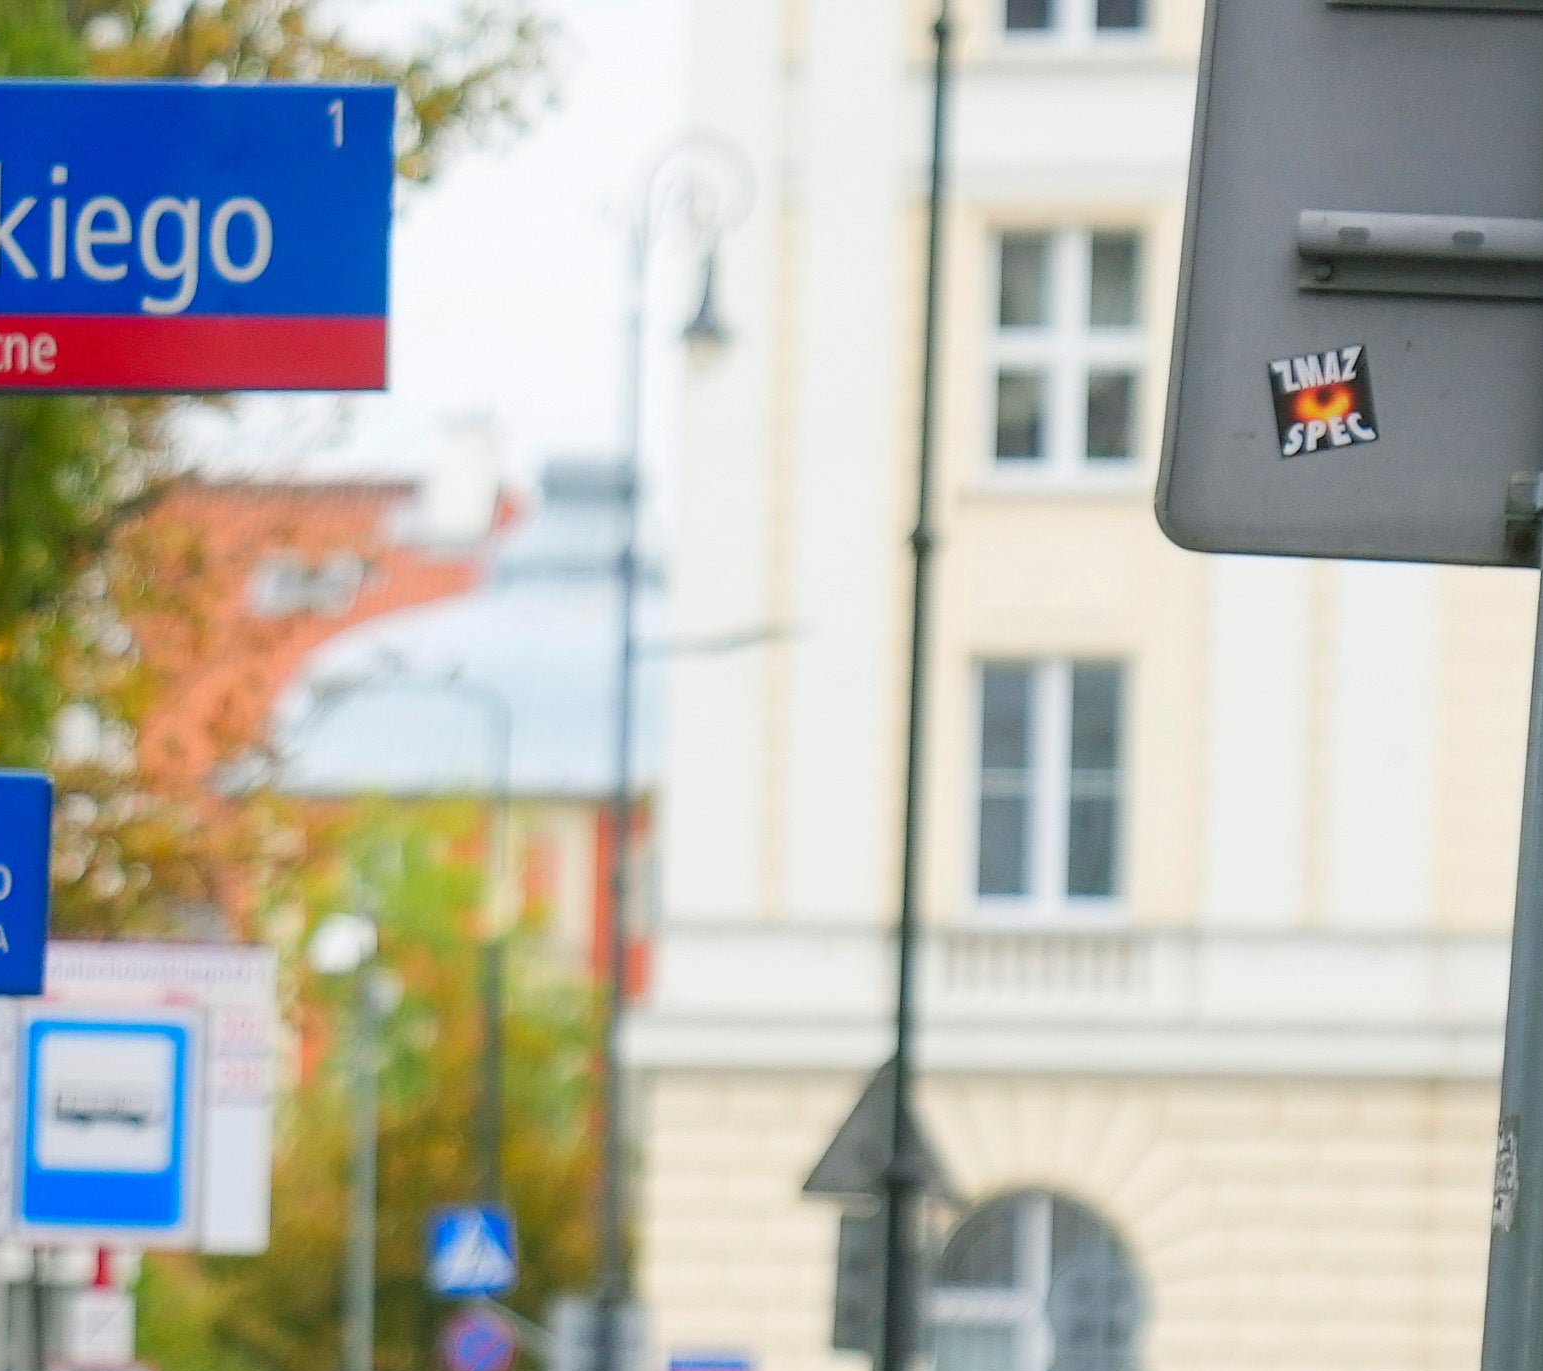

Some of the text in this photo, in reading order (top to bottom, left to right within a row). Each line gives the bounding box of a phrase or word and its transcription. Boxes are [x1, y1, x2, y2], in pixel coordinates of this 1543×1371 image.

[328, 100, 343, 147] 1
[1272, 345, 1363, 392] ZMAZ
[1283, 413, 1377, 455] SPEC
